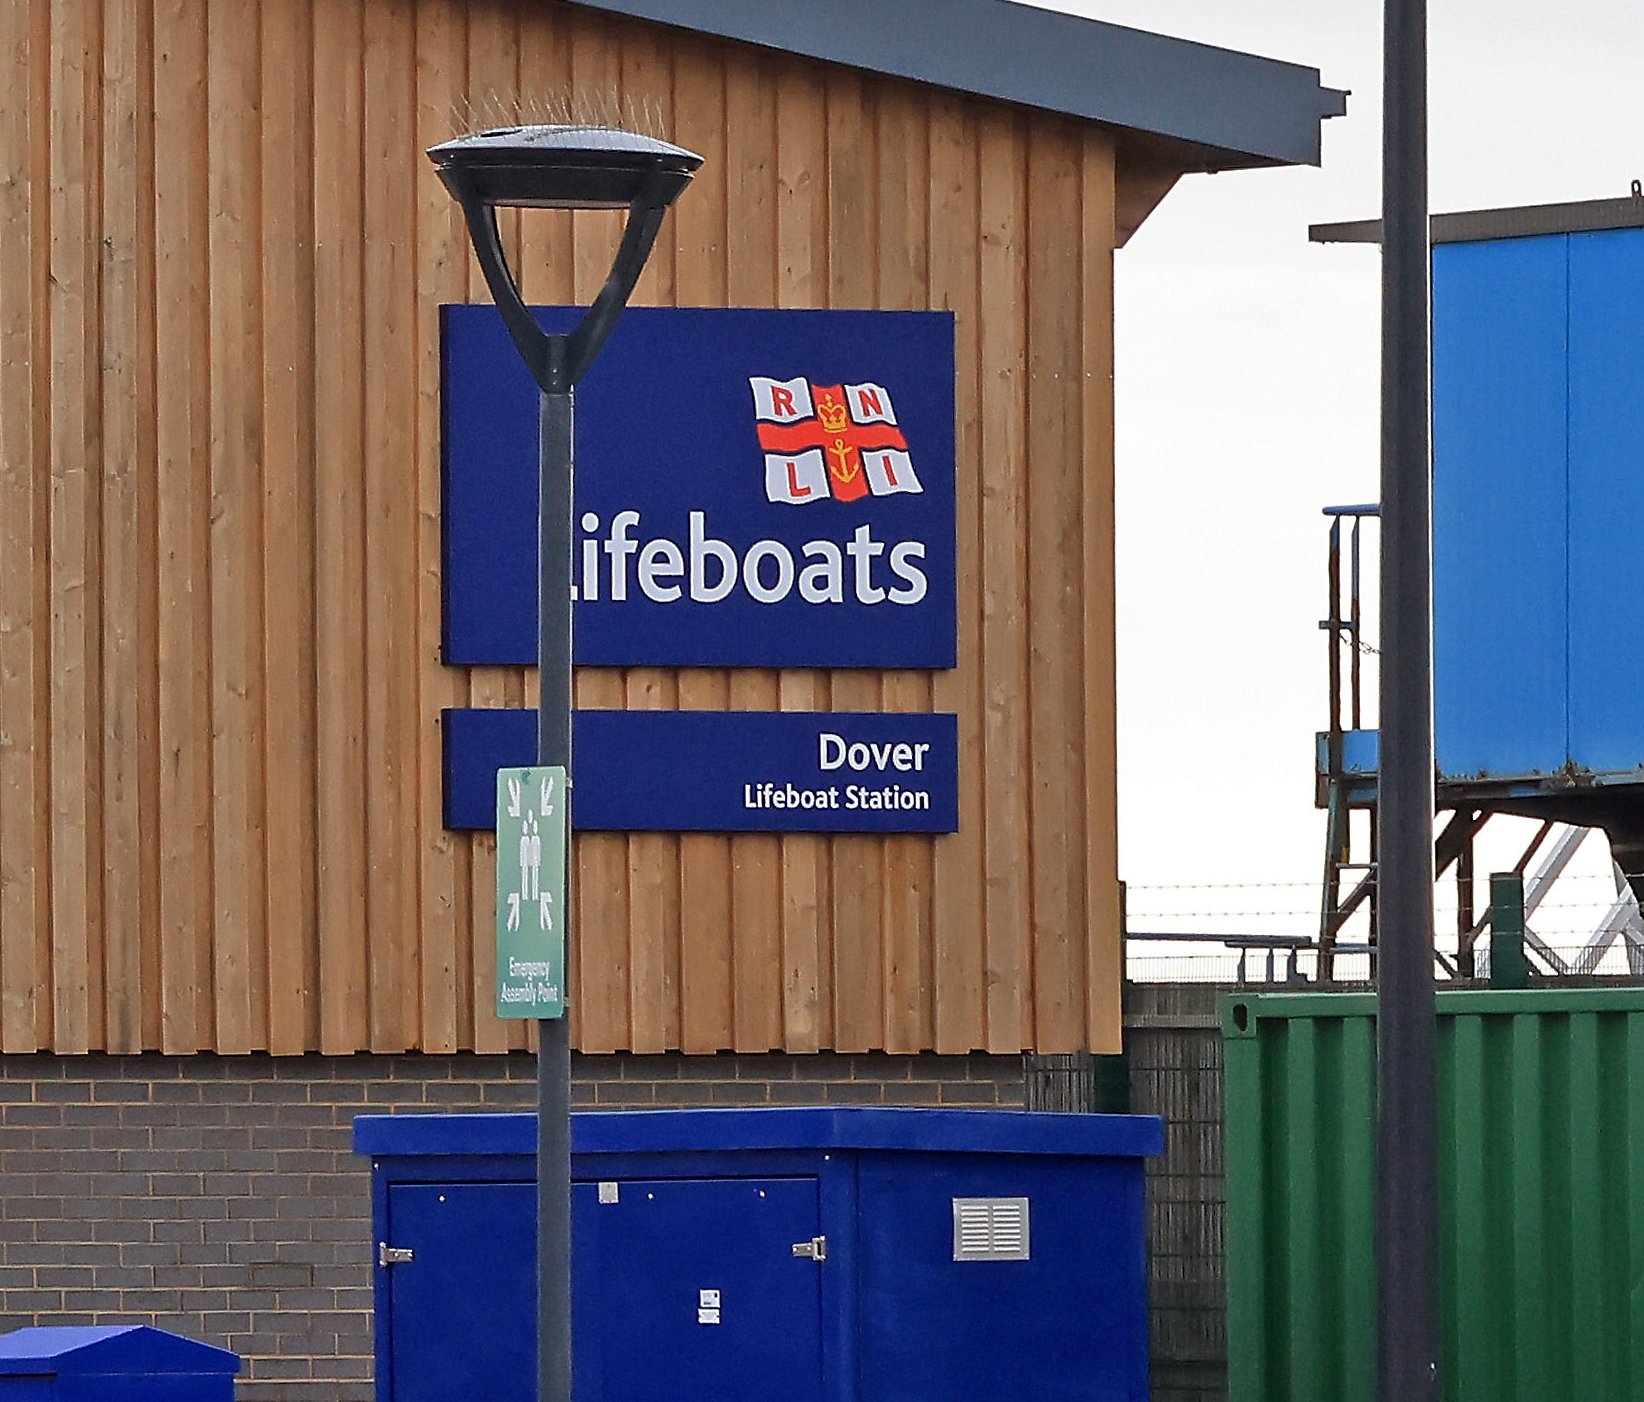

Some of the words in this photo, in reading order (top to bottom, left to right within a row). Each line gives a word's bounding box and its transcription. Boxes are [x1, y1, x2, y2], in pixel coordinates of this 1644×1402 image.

[570, 510, 928, 605] ifeboats
[819, 734, 930, 772] Dover
[744, 785, 839, 810] Lifeboat
[845, 785, 930, 811] Station
[509, 956, 550, 981] Emergency
[500, 982, 536, 1006] Assembly
[537, 982, 558, 1003] Point
